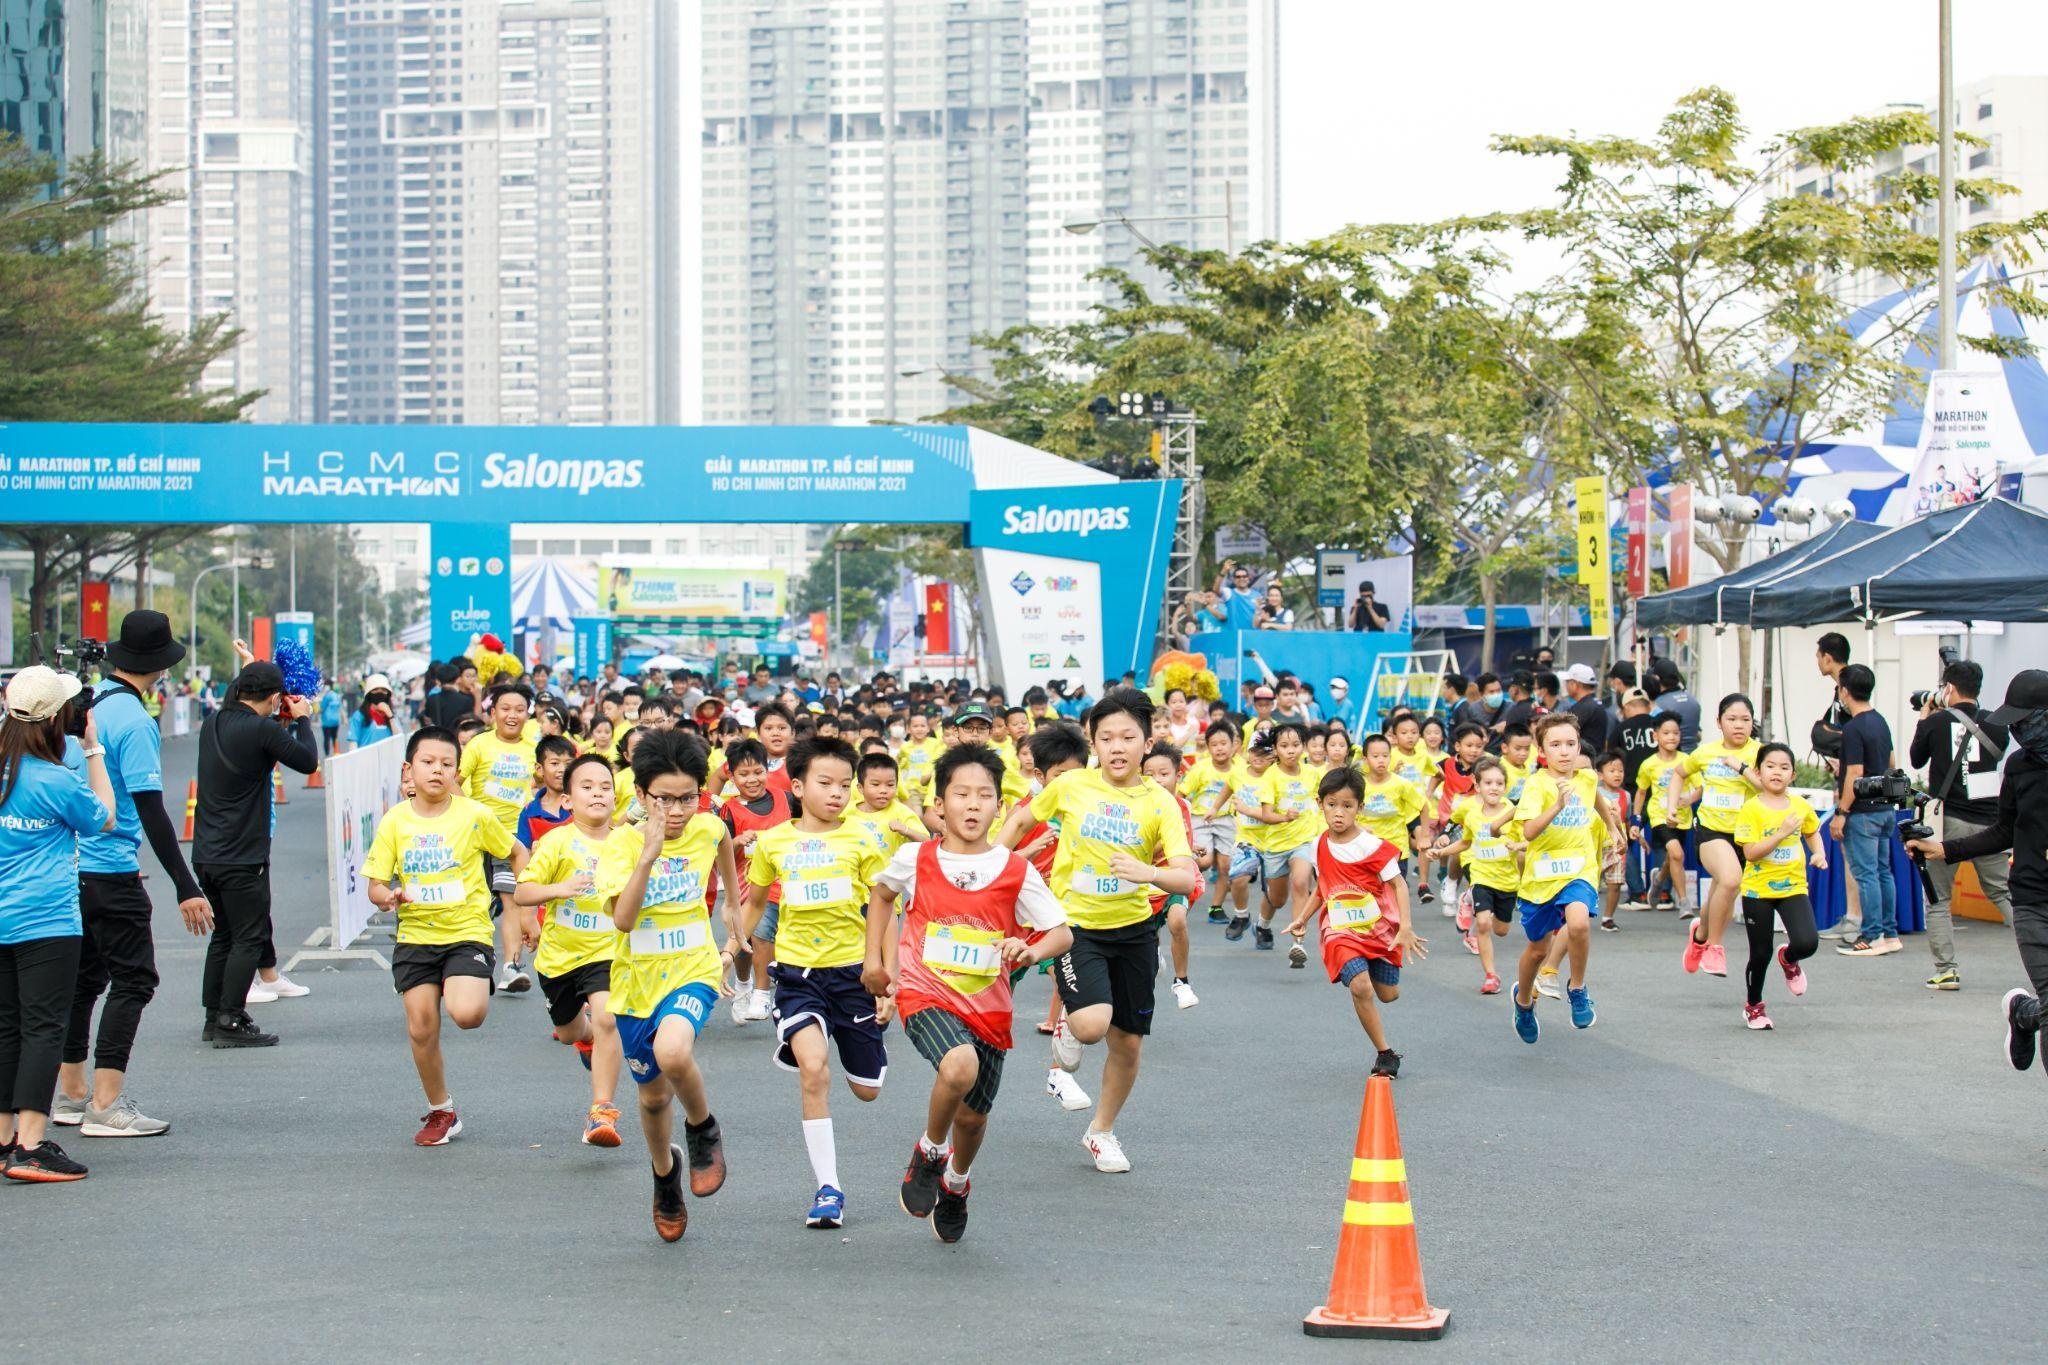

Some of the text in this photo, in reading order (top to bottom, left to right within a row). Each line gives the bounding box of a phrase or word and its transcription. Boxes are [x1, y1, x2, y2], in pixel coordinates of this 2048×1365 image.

[1935, 411, 1988, 421] MARATHON
[1956, 440, 1990, 450] Salonpas
[19, 457, 91, 472] MARATHON
[94, 457, 113, 472] TP.
[139, 454, 163, 472] CHÍ
[166, 457, 201, 472] MINH
[739, 459, 808, 474] MARATHON
[811, 459, 831, 474] TP.
[855, 455, 878, 474] CHÍ
[881, 459, 914, 474] MINH
[481, 452, 645, 495] Salonpas
[11, 475, 32, 490] CHI
[35, 475, 66, 490] MINH
[68, 475, 94, 490] CITY
[97, 475, 161, 490] MARATHON
[164, 475, 192, 490] 2021
[264, 476, 459, 496] MARATHON
[712, 476, 906, 491] HO CHI MINH CITY MARATHON 2021
[1002, 504, 1131, 537] Salonpas
[1589, 535, 1598, 567] 3
[1633, 545, 1641, 577] 2
[1677, 546, 1683, 575] 1
[634, 581, 675, 592] THINK
[451, 595, 490, 621] pulse
[451, 621, 491, 631] active
[1622, 728, 1659, 750] 540
[1716, 796, 1730, 806] 155
[1085, 813, 1139, 835] RONNY
[405, 847, 453, 862] RONNY
[785, 853, 835, 865] RONNY
[1481, 848, 1495, 858] 111
[1774, 848, 1791, 859] 239
[403, 862, 440, 873] DASH
[1551, 860, 1570, 873] 012
[646, 872, 700, 891] RONNY
[1096, 878, 1118, 893] 153
[421, 886, 443, 901] 211
[804, 883, 829, 901] 165
[574, 913, 598, 929] 061
[1346, 909, 1365, 920] 174
[658, 930, 685, 949] 110
[952, 944, 978, 965] 171
[673, 994, 704, 1021] 10
